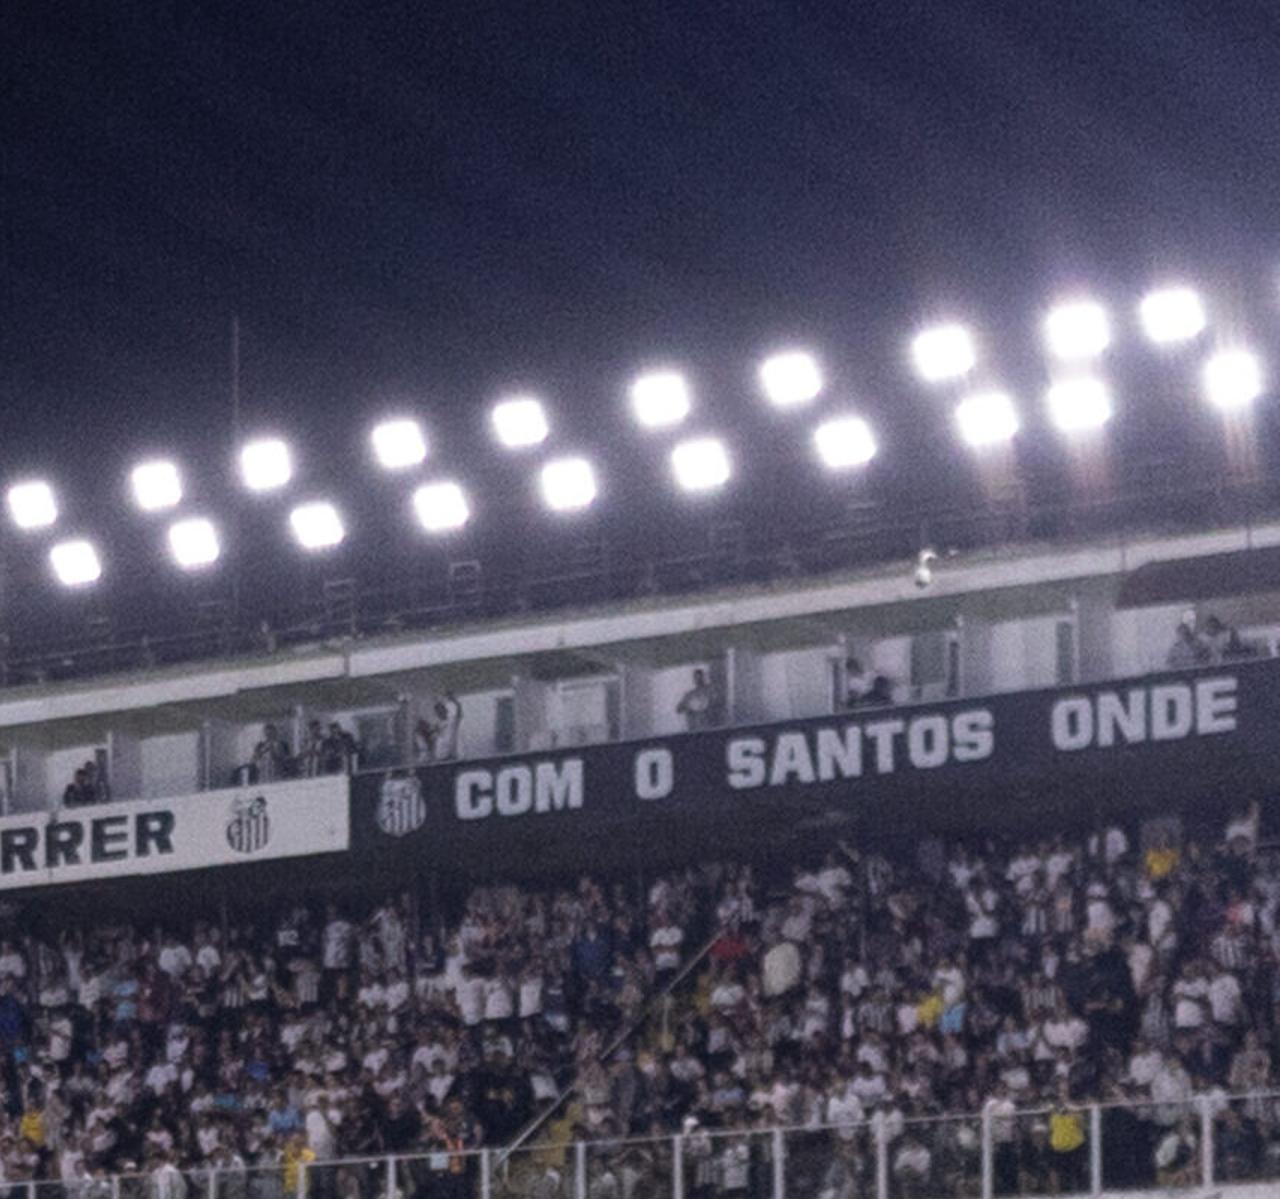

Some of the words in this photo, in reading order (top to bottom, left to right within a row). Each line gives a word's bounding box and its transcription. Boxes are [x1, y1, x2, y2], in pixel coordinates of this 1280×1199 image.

[455, 760, 584, 821] COM
[635, 749, 674, 800] O
[726, 711, 994, 789] SANTOS
[1052, 677, 1238, 752] ONDE
